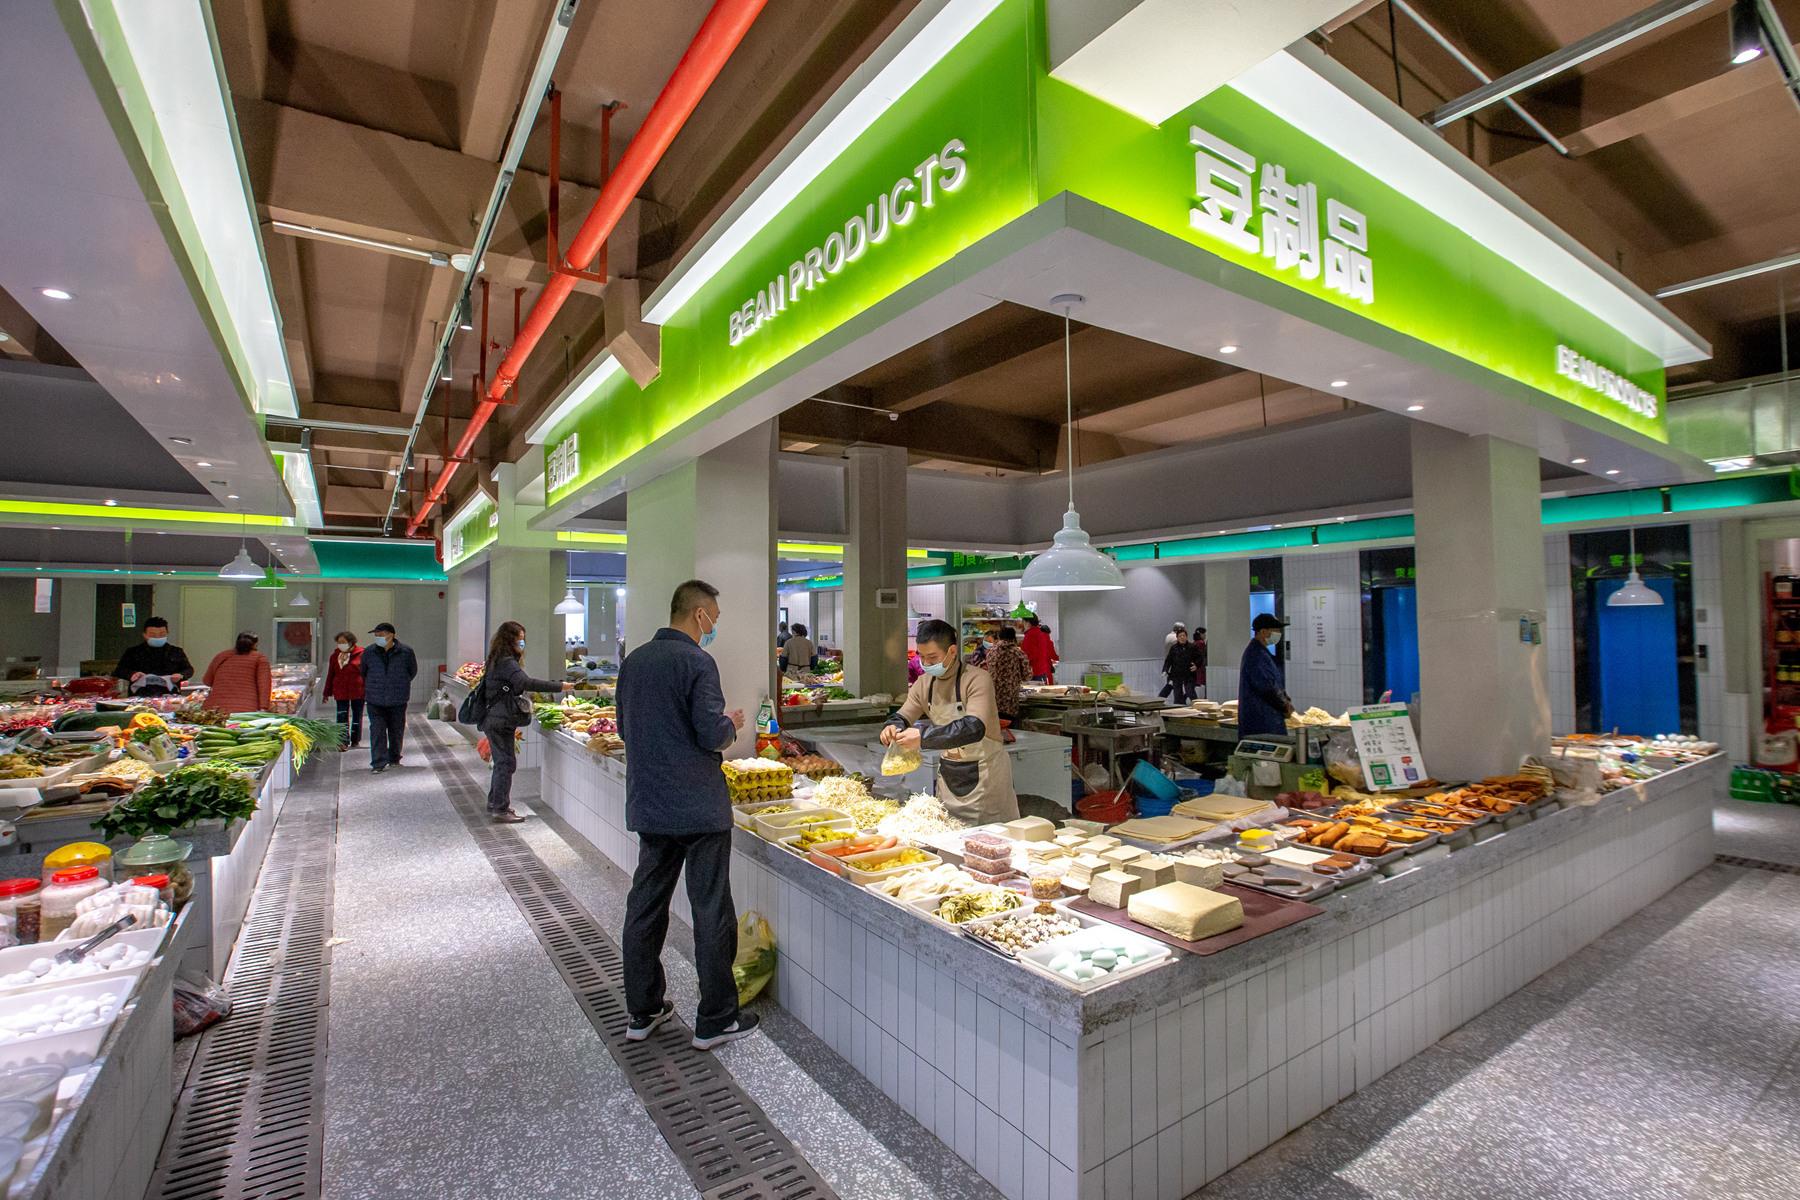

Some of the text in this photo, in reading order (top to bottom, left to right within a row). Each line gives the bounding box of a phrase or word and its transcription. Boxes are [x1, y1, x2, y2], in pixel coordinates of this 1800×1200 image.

[729, 138, 967, 346] BEAN PRODUCTS
[1190, 125, 1374, 304] 豆制品
[1557, 344, 1658, 419] BEAN PRODUCTS
[547, 432, 580, 493] 豆制品
[1312, 596, 1327, 610] 1F
